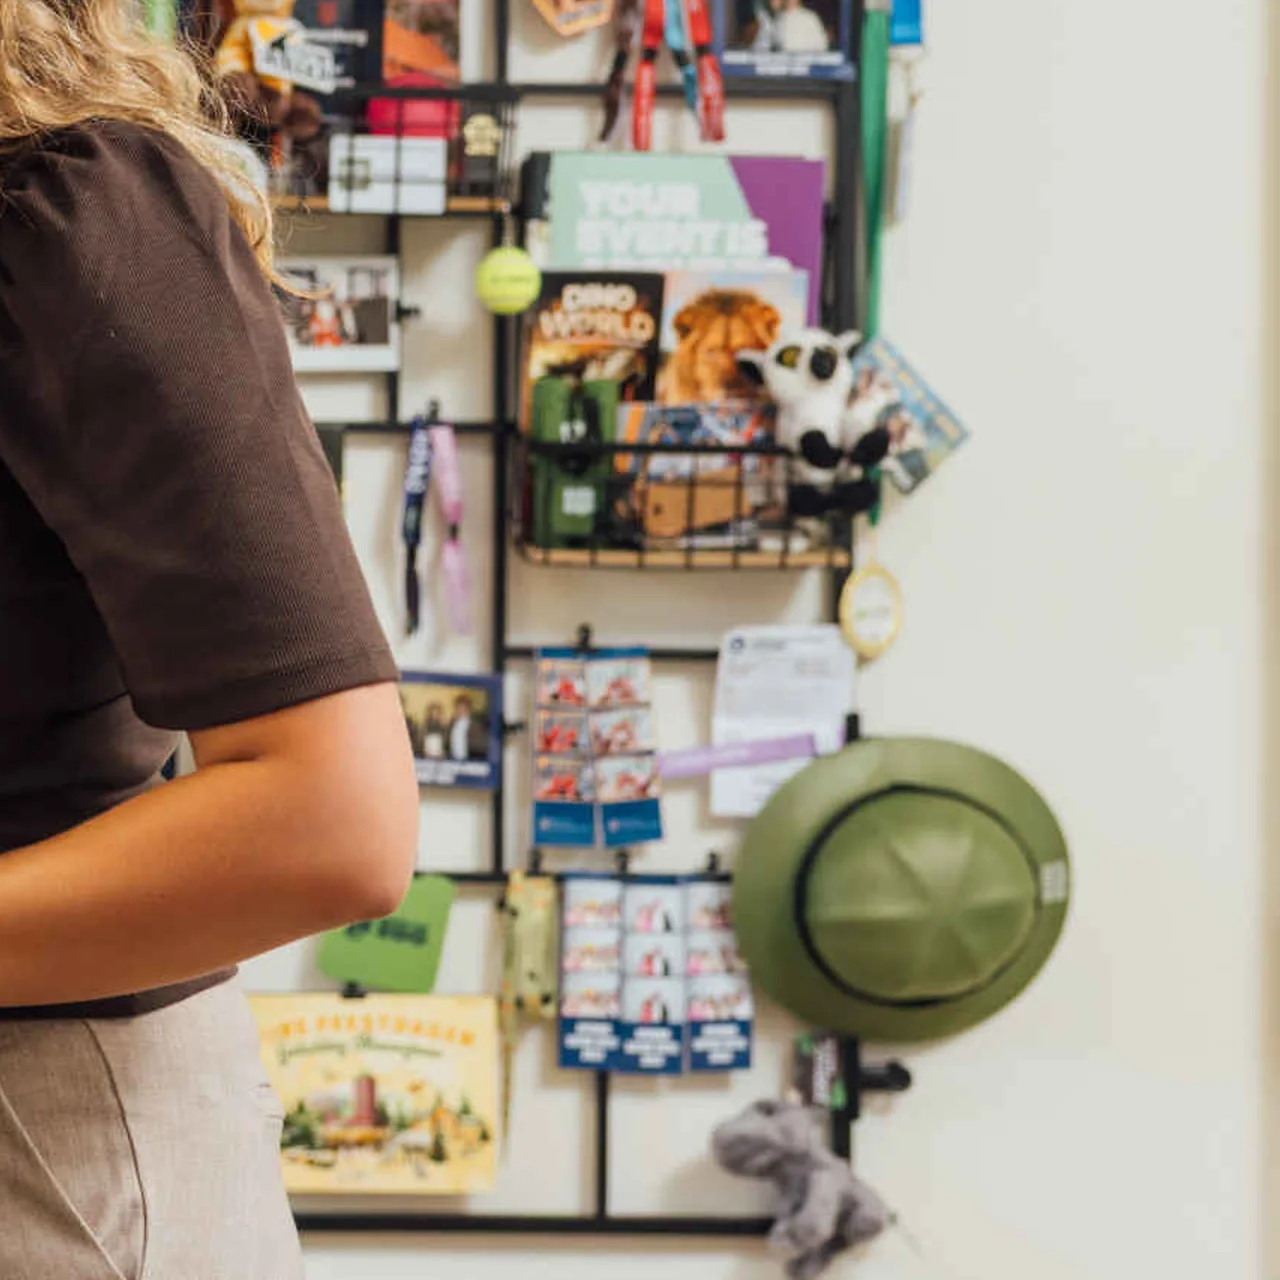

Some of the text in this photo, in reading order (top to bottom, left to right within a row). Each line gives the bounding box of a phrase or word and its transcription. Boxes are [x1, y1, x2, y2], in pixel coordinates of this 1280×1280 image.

[579, 181, 699, 218] YOUR
[577, 219, 769, 256] EVENT IS
[562, 283, 637, 312] DINO
[540, 309, 656, 342] WORLD
